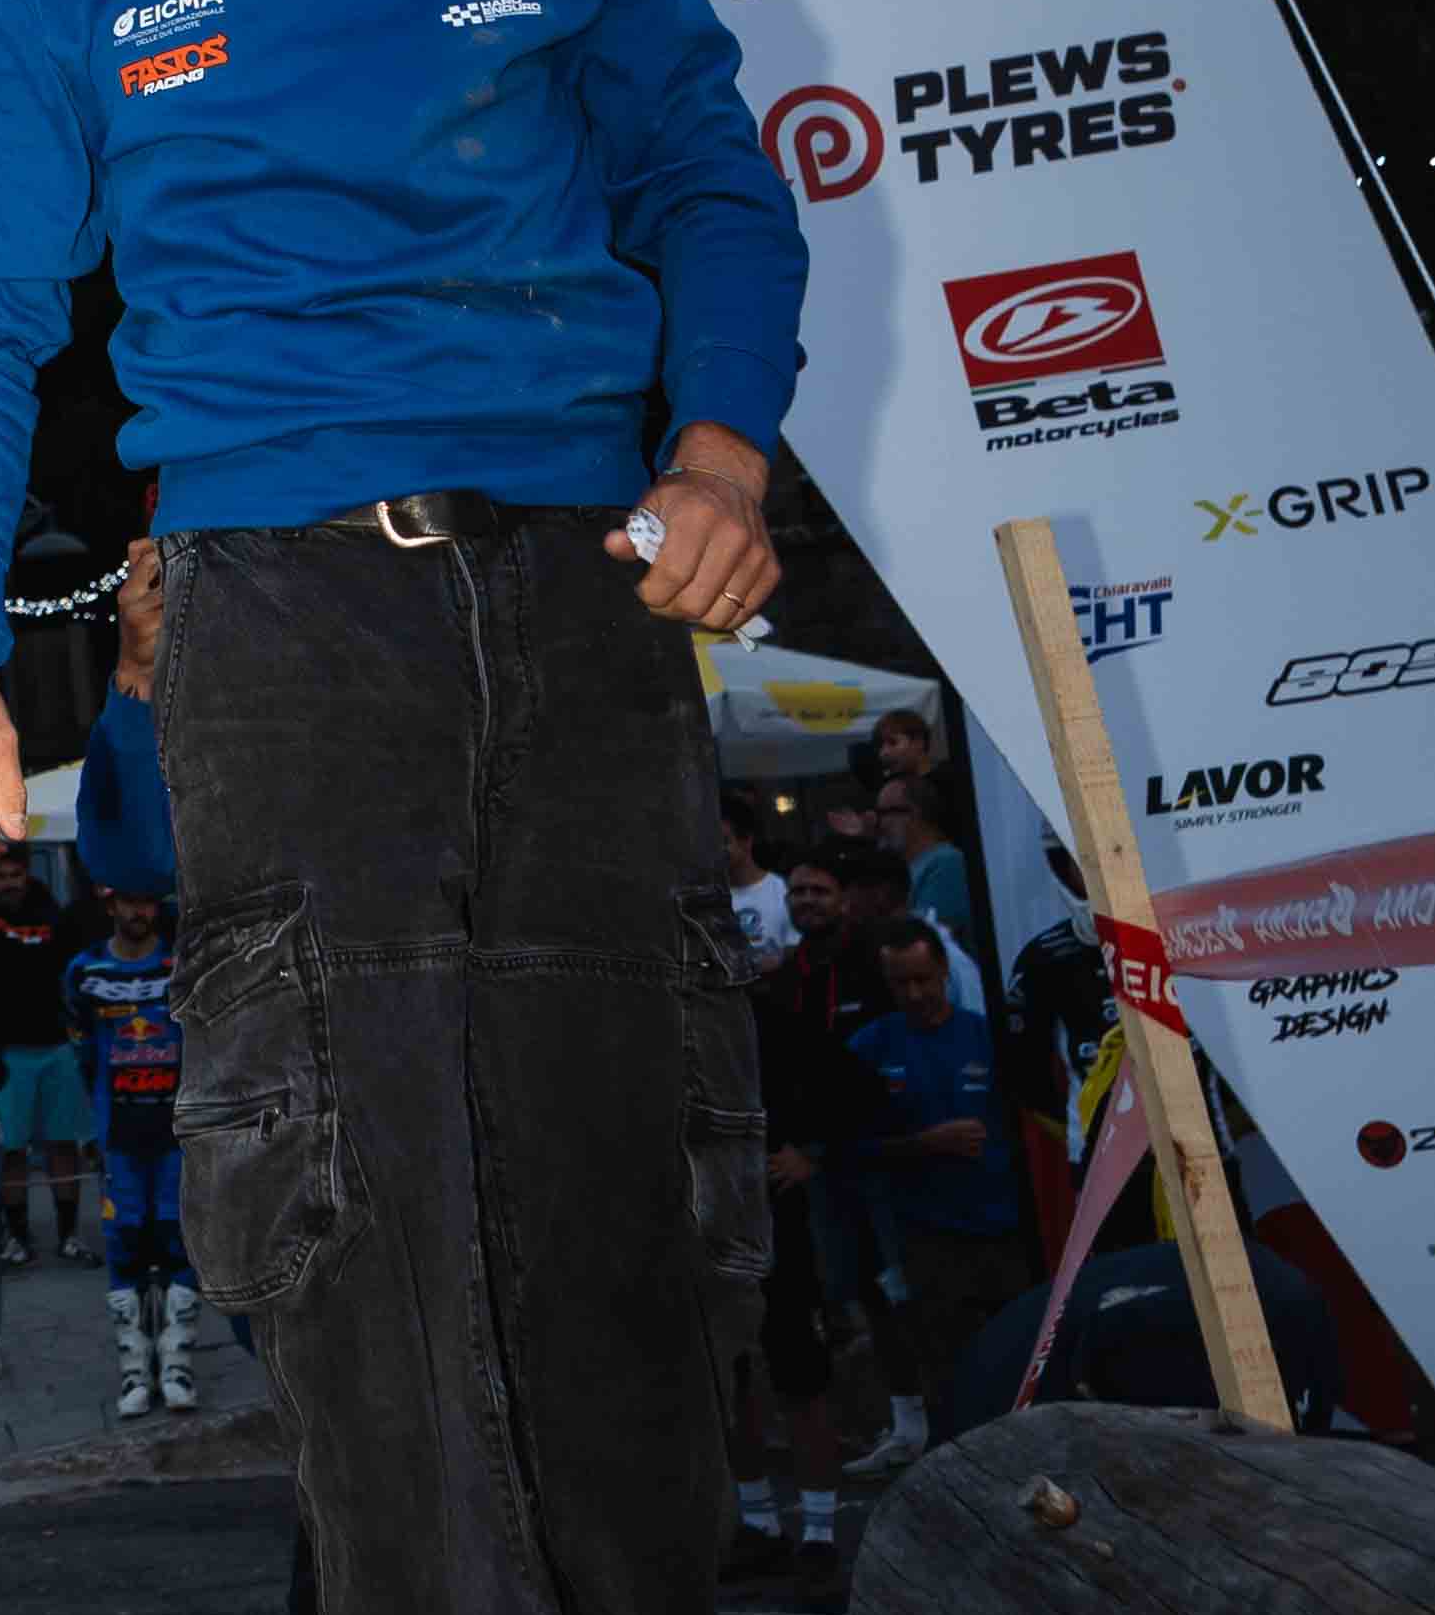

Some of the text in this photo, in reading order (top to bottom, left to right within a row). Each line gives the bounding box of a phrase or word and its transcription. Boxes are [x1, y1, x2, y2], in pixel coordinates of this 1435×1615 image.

[120, 33, 229, 97] FASTOS
[143, 67, 205, 97] RACING
[894, 32, 1172, 125] PLEWS
[901, 90, 1177, 186] TYRES
[974, 377, 1176, 431] Beta
[986, 406, 1180, 452] motorcycles
[1193, 466, 1431, 541] X-GRIP
[1093, 575, 1173, 600] Chiaravalli
[1145, 753, 1327, 816] LAVOR
[1173, 800, 1303, 832] SIMPLY STRONGER
[1248, 967, 1400, 1010] GRAPHICS
[1270, 998, 1392, 1043] DESIGN
